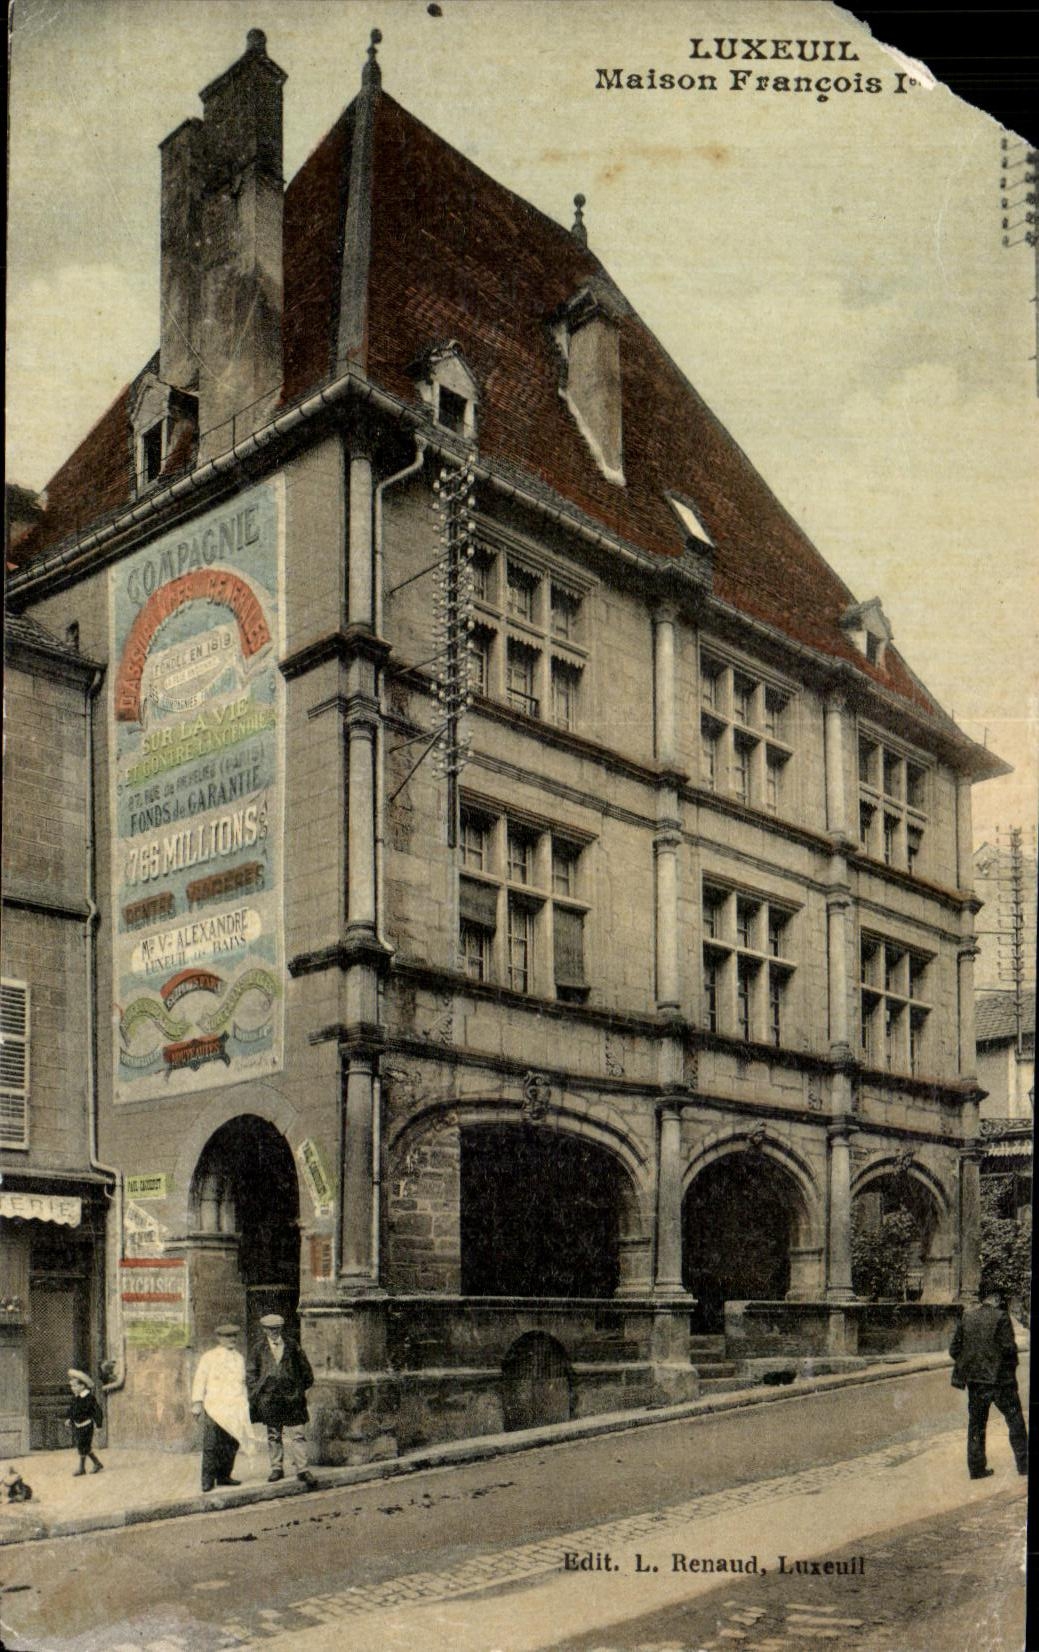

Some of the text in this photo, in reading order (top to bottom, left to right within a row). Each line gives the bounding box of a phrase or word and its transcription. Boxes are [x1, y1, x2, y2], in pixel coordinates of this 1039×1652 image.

[127, 504, 261, 602] COMPAGNIE
[142, 697, 249, 756] SUR LA VIE
[131, 804, 171, 837] FONDS
[188, 765, 262, 814] GARANTIE
[163, 804, 258, 876] MILLIONS
[177, 908, 248, 949] ALEXANDRE
